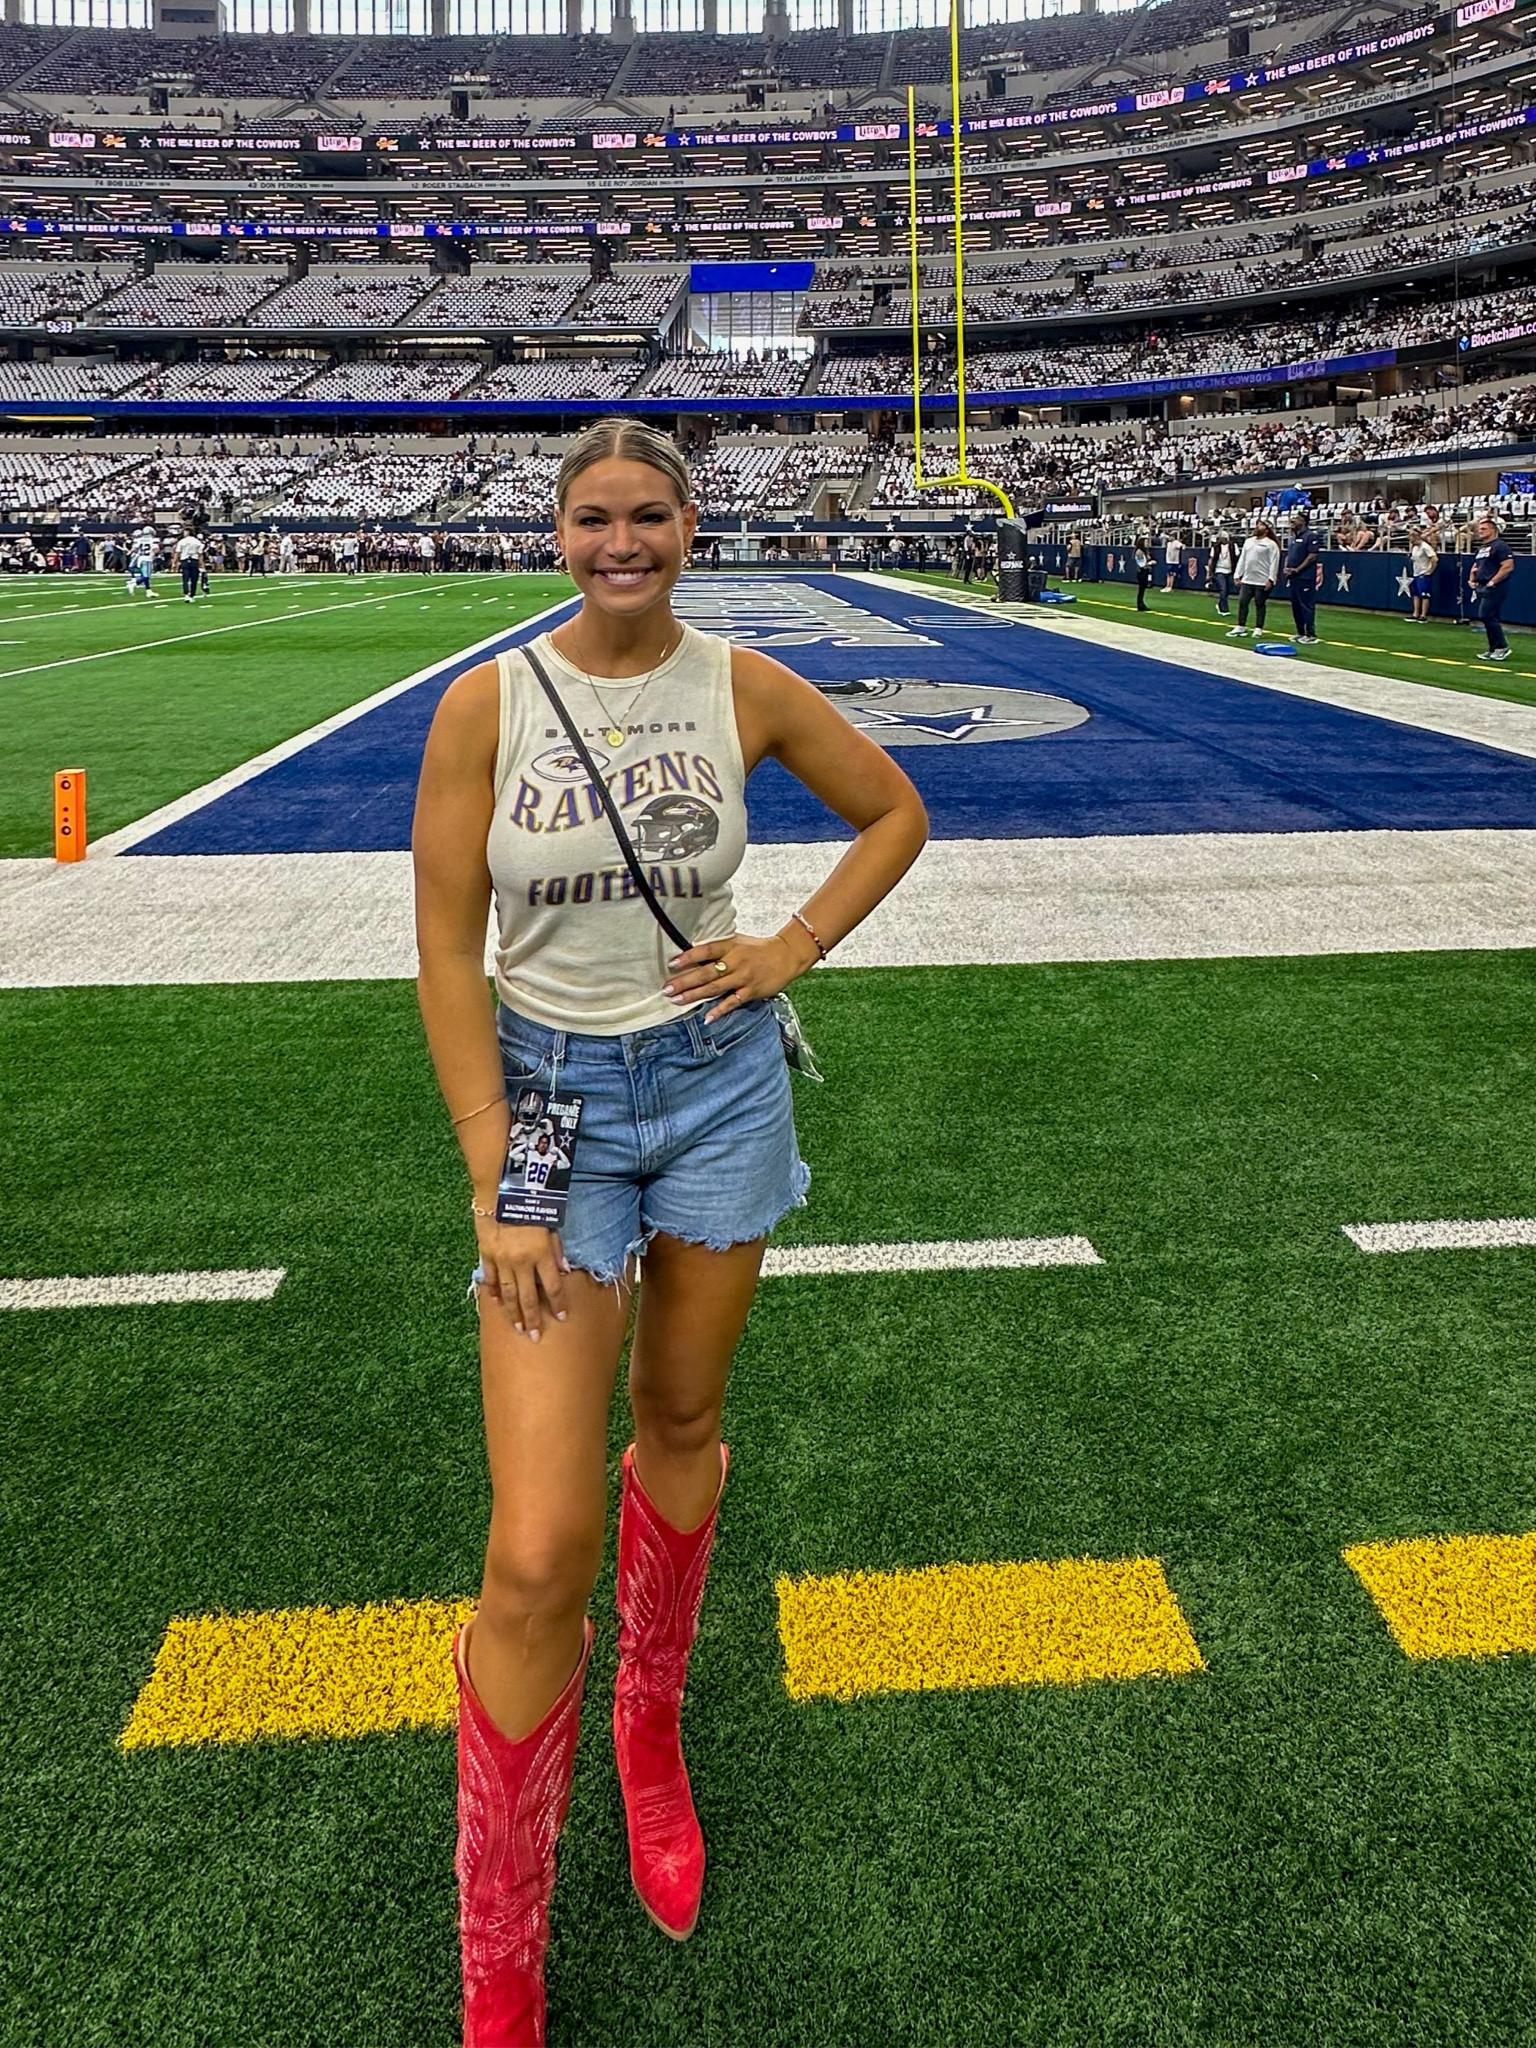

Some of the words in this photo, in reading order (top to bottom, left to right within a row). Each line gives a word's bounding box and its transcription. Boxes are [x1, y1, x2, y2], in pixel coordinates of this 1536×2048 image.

[1265, 69, 1285, 81] THE
[1307, 53, 1335, 70] BEER
[1338, 49, 1353, 62] OF
[1355, 42, 1378, 58] THE
[1380, 24, 1435, 49] COWBOYS
[1318, 103, 1346, 118] DREW
[1348, 92, 1394, 109] PEARSON
[968, 121, 987, 131] THE
[1006, 115, 1032, 127] BEER
[1034, 114, 1047, 124] OF
[1050, 110, 1068, 122] THE
[1070, 103, 1117, 119] COWBOYS
[696, 135, 714, 144] THE
[732, 133, 756, 143] BEER
[758, 132, 770, 142] OF
[772, 131, 791, 141] THE
[792, 131, 837, 141] COWBOYS
[1384, 146, 1402, 157] THE
[1420, 138, 1444, 150] BEER
[1445, 134, 1457, 143] OF
[1459, 130, 1477, 139] THE
[1479, 114, 1526, 134] COWBOYS
[157, 138, 176, 147] THE
[195, 139, 220, 148] BEER
[222, 139, 234, 148] OF
[237, 140, 254, 148] THE
[256, 140, 300, 149] COWBOYS
[436, 140, 454, 148] THE
[472, 139, 496, 148] BEER
[498, 139, 510, 148] OF
[512, 139, 530, 148] THE
[532, 138, 576, 148] COWBOYS
[1126, 146, 1143, 155] TEX
[1146, 138, 1188, 152] SCHRAMM
[948, 167, 969, 175] TNY
[972, 164, 1008, 173] DORSETT
[1213, 178, 1252, 192] COWBOYS
[985, 209, 1021, 220] COWBOYS
[343, 227, 377, 235] COWBOYS
[550, 226, 584, 234] COWBOYS
[760, 221, 794, 229] COWBOYS
[1227, 373, 1272, 385] COWBOYS
[544, 721, 696, 738] BLTMORE
[527, 1161, 549, 1184] 26
